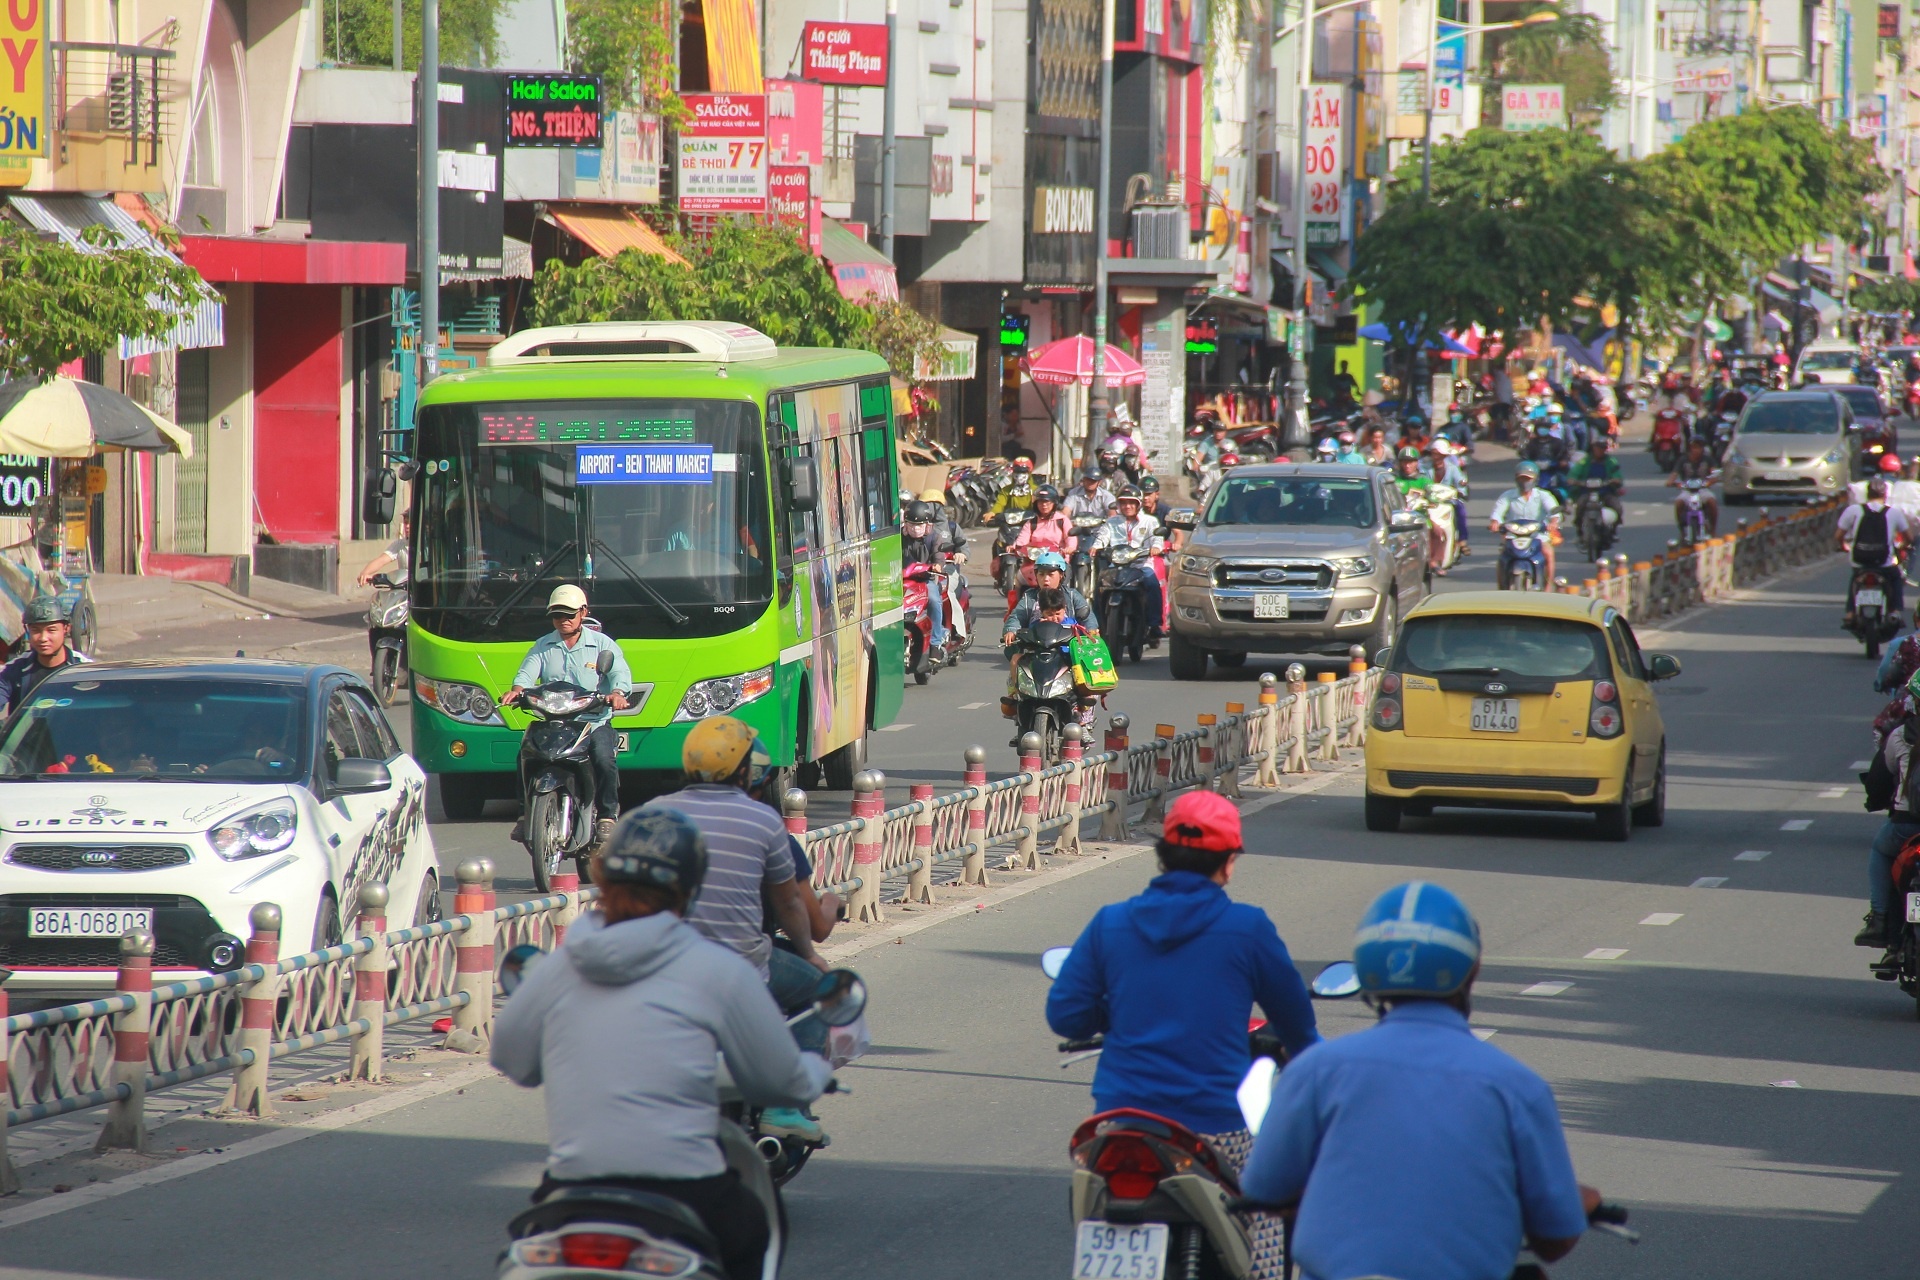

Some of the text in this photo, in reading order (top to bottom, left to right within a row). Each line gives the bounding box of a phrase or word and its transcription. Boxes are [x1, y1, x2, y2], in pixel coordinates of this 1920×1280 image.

[848, 50, 881, 74] Phạm
[512, 79, 595, 99] Hair Salon
[1536, 92, 1561, 109] TA
[695, 104, 749, 116] SAIGON
[511, 104, 597, 143] NG. THIỆN
[682, 142, 765, 168] QUÁN 77
[1045, 188, 1093, 232] BON BON
[579, 454, 615, 474] AIRPORT
[625, 454, 642, 474] BEN
[645, 454, 673, 473] THANH
[675, 454, 710, 474] MARKET
[1262, 595, 1280, 605] 60C
[1255, 606, 1287, 616] 344.58
[1483, 700, 1508, 715] 61A
[1472, 715, 1517, 730] 014.40
[90, 796, 107, 806] KIA
[16, 818, 169, 827] DISCOVER
[85, 852, 107, 863] KIA
[35, 912, 147, 937] 86A-068.03
[1092, 1227, 1150, 1252] 59-C1
[1080, 1253, 1158, 1280] 272.53
